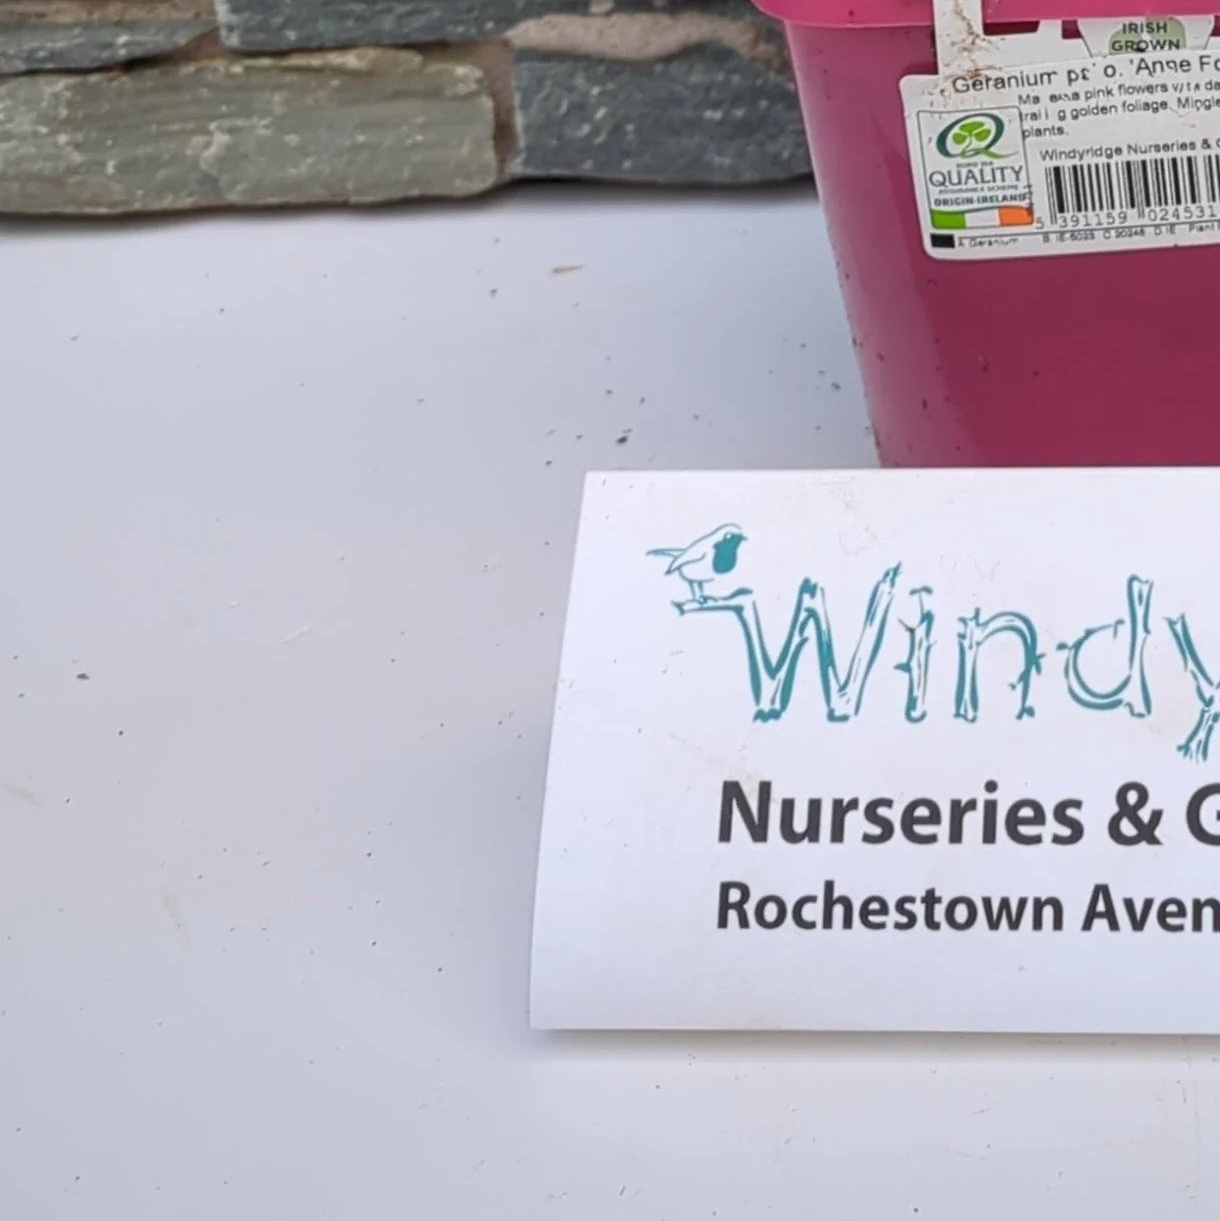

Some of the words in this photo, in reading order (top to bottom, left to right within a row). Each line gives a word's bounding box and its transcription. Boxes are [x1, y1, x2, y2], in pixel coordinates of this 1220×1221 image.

[1121, 22, 1168, 34] IRISH
[1111, 39, 1180, 52] GROWN
[1084, 84, 1113, 102] pink
[1118, 82, 1168, 96] flowers
[1071, 101, 1119, 120] golden
[1039, 146, 1123, 162] Windyridge
[1127, 140, 1196, 155] Nurseries
[1201, 138, 1211, 150] &
[929, 165, 1024, 188] QUALITY
[1035, 216, 1045, 230] 5
[1059, 211, 1128, 228] 391159
[1147, 204, 1217, 222] 024531
[718, 780, 1085, 845] Nurseries
[1107, 781, 1164, 846] &
[717, 879, 1064, 932] Rochestown
